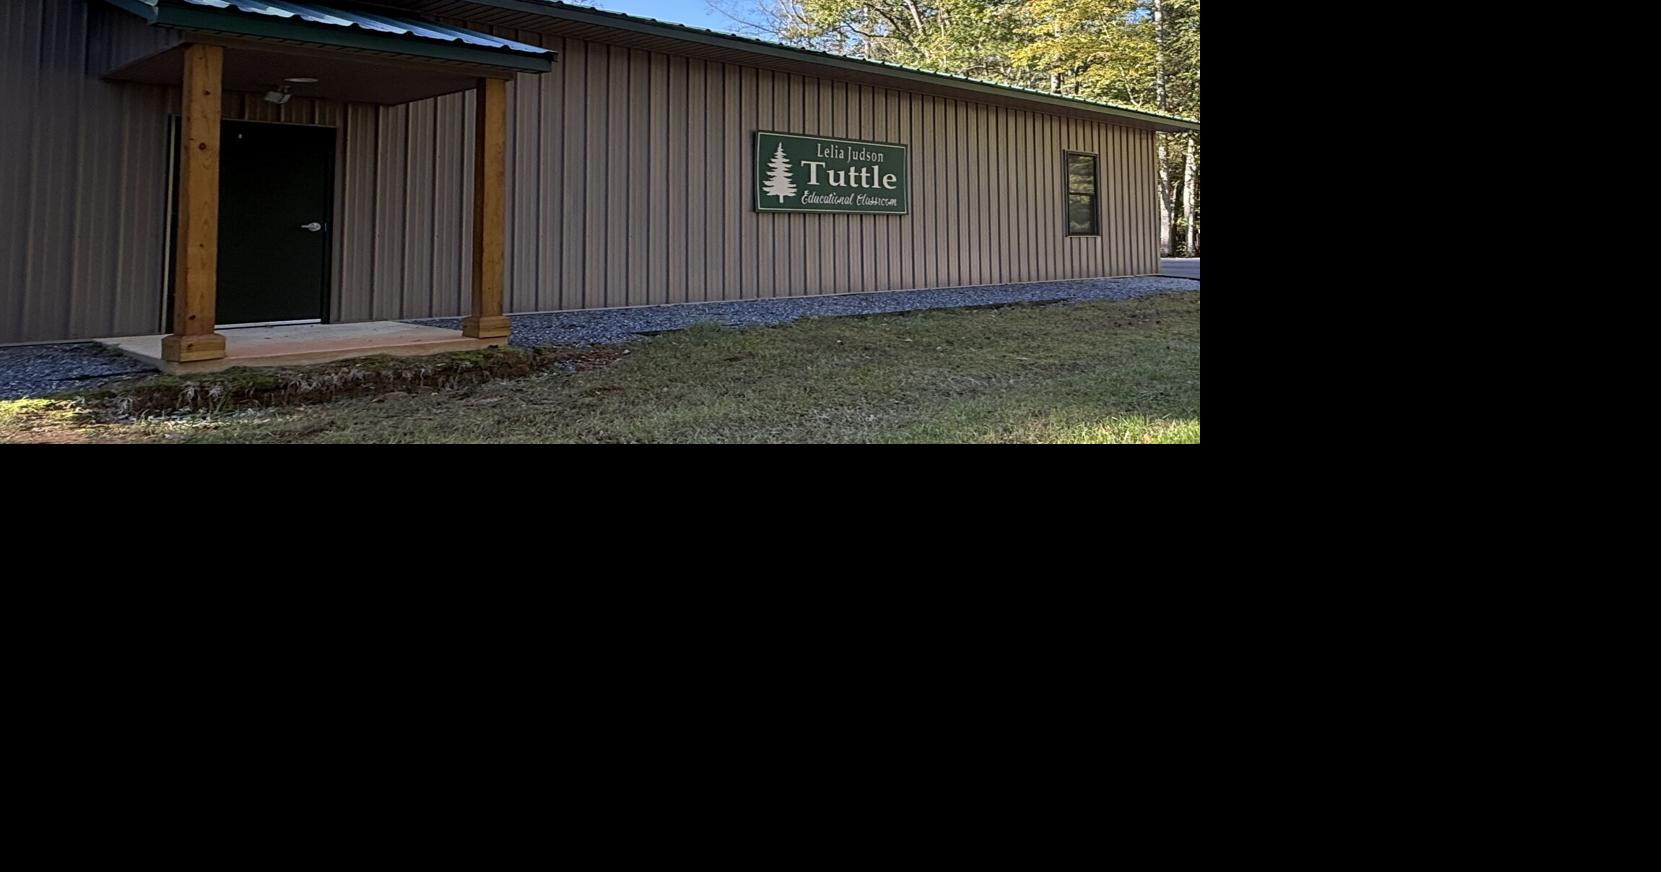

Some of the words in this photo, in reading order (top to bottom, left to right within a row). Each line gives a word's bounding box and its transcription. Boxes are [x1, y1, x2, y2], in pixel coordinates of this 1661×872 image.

[817, 143, 844, 160] Lelia
[847, 146, 884, 163] Judson
[801, 160, 897, 190] Tuttle
[801, 190, 855, 205] Educational
[856, 193, 897, 207] Classroom
